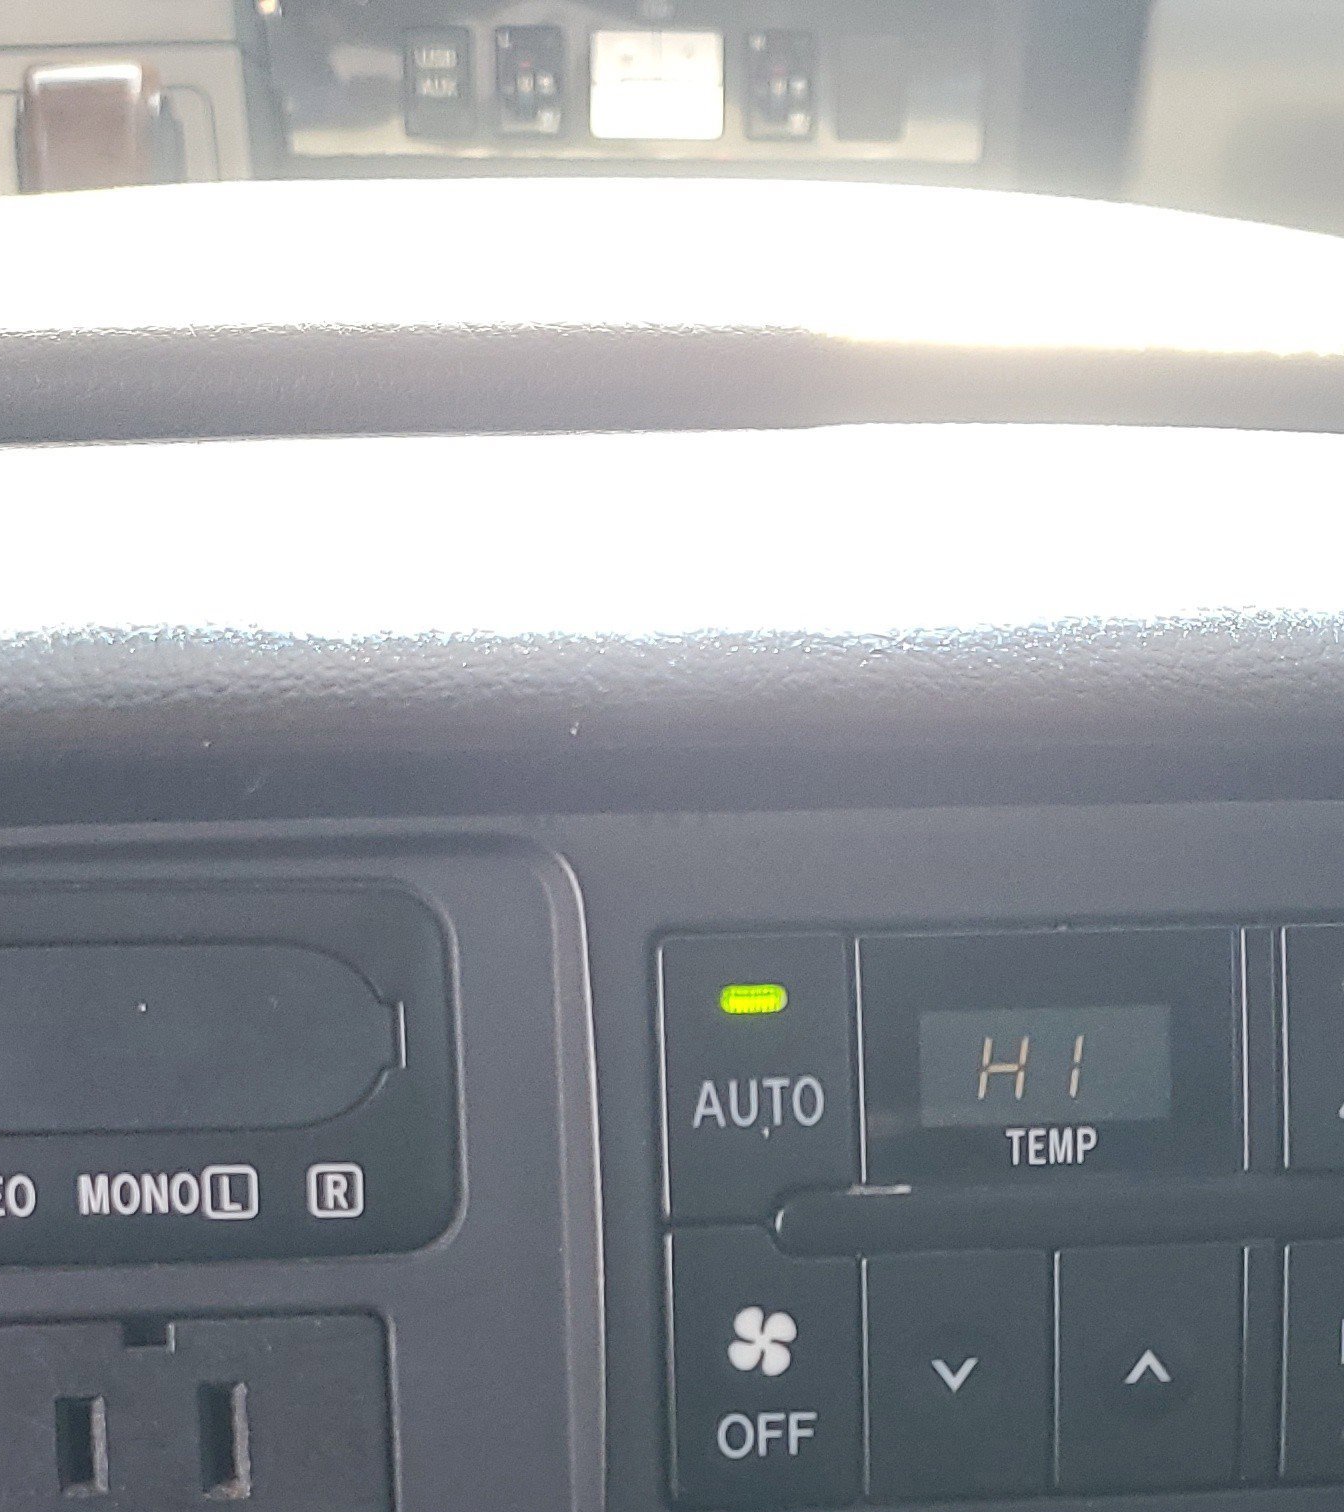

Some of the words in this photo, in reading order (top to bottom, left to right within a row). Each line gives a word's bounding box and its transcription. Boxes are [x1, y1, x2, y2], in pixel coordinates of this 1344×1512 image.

[692, 1075, 825, 1128] AUTO
[1005, 1127, 1099, 1165] TEMP
[716, 1411, 818, 1459] OFF
